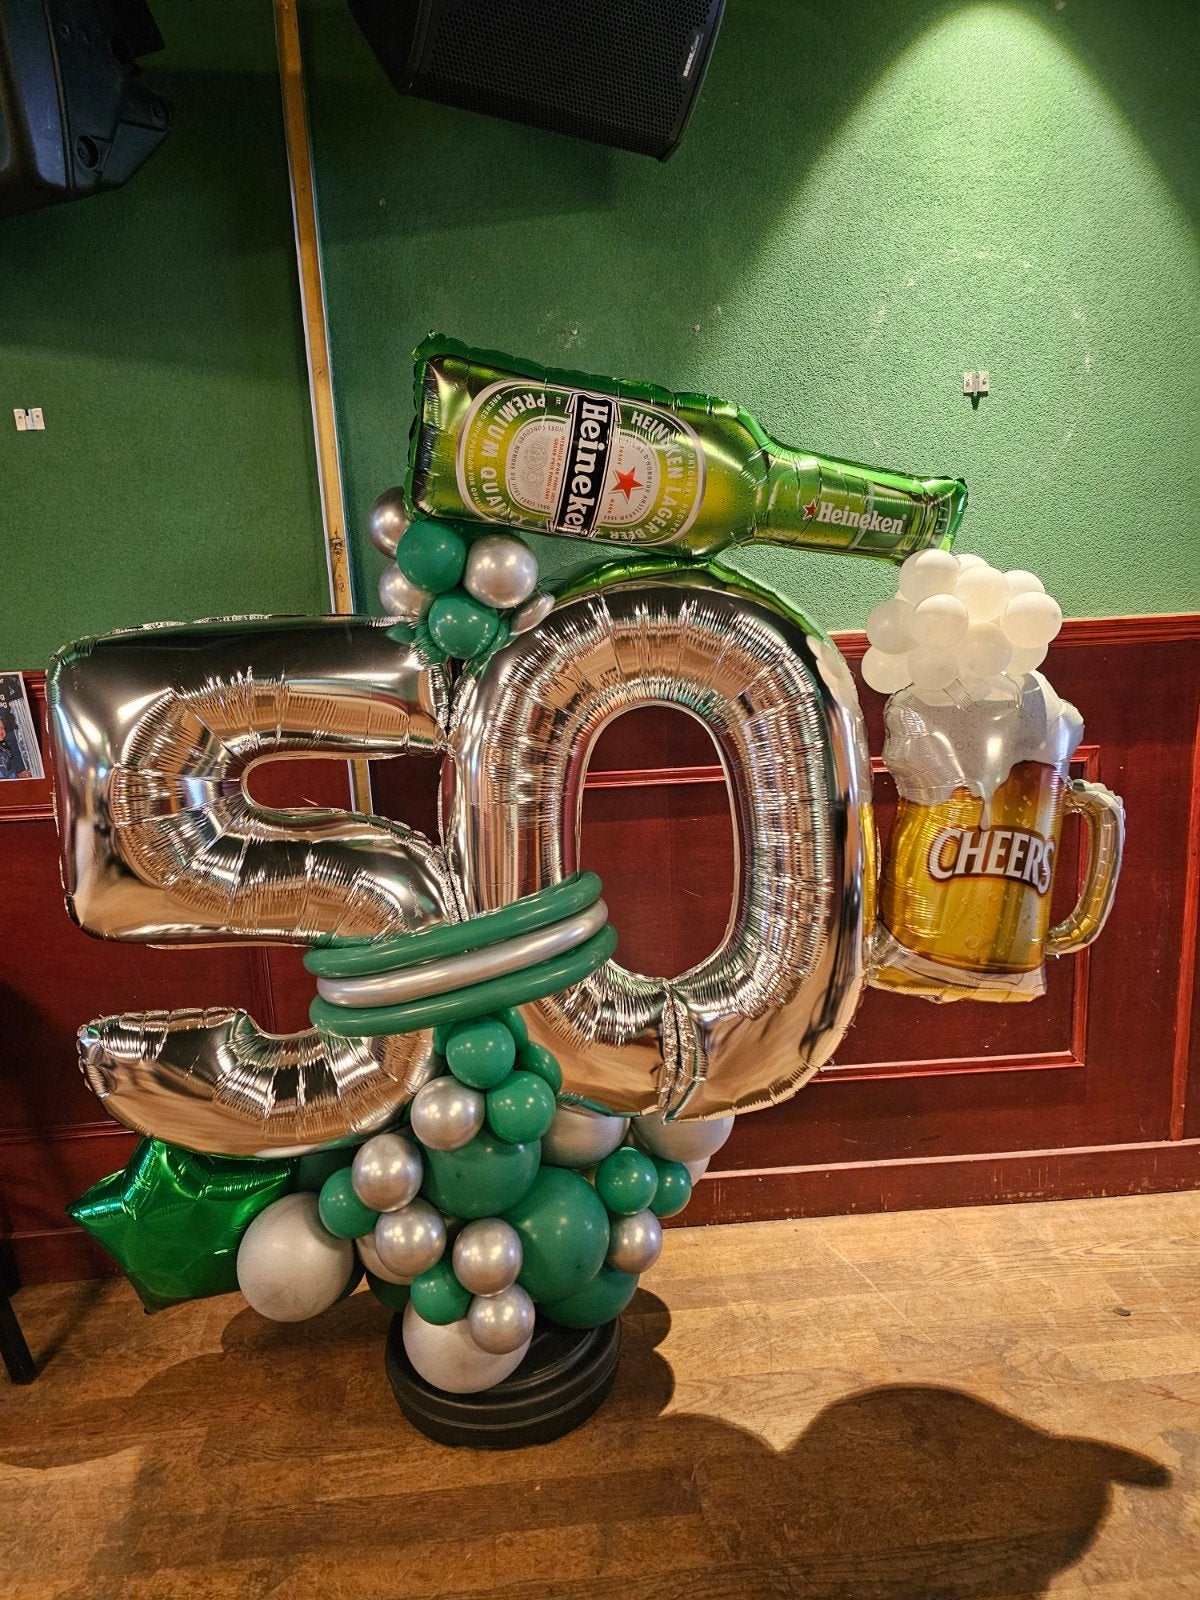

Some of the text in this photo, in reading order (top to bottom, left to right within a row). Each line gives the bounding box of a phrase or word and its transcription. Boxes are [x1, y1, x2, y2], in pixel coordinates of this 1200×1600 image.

[480, 393, 503, 420] BREWED
[480, 392, 547, 458] PREMIUM
[643, 485, 682, 534] LAGER
[671, 503, 690, 534] RECIPE
[815, 501, 904, 535] Heineken
[929, 828, 1055, 894] CHEERS
